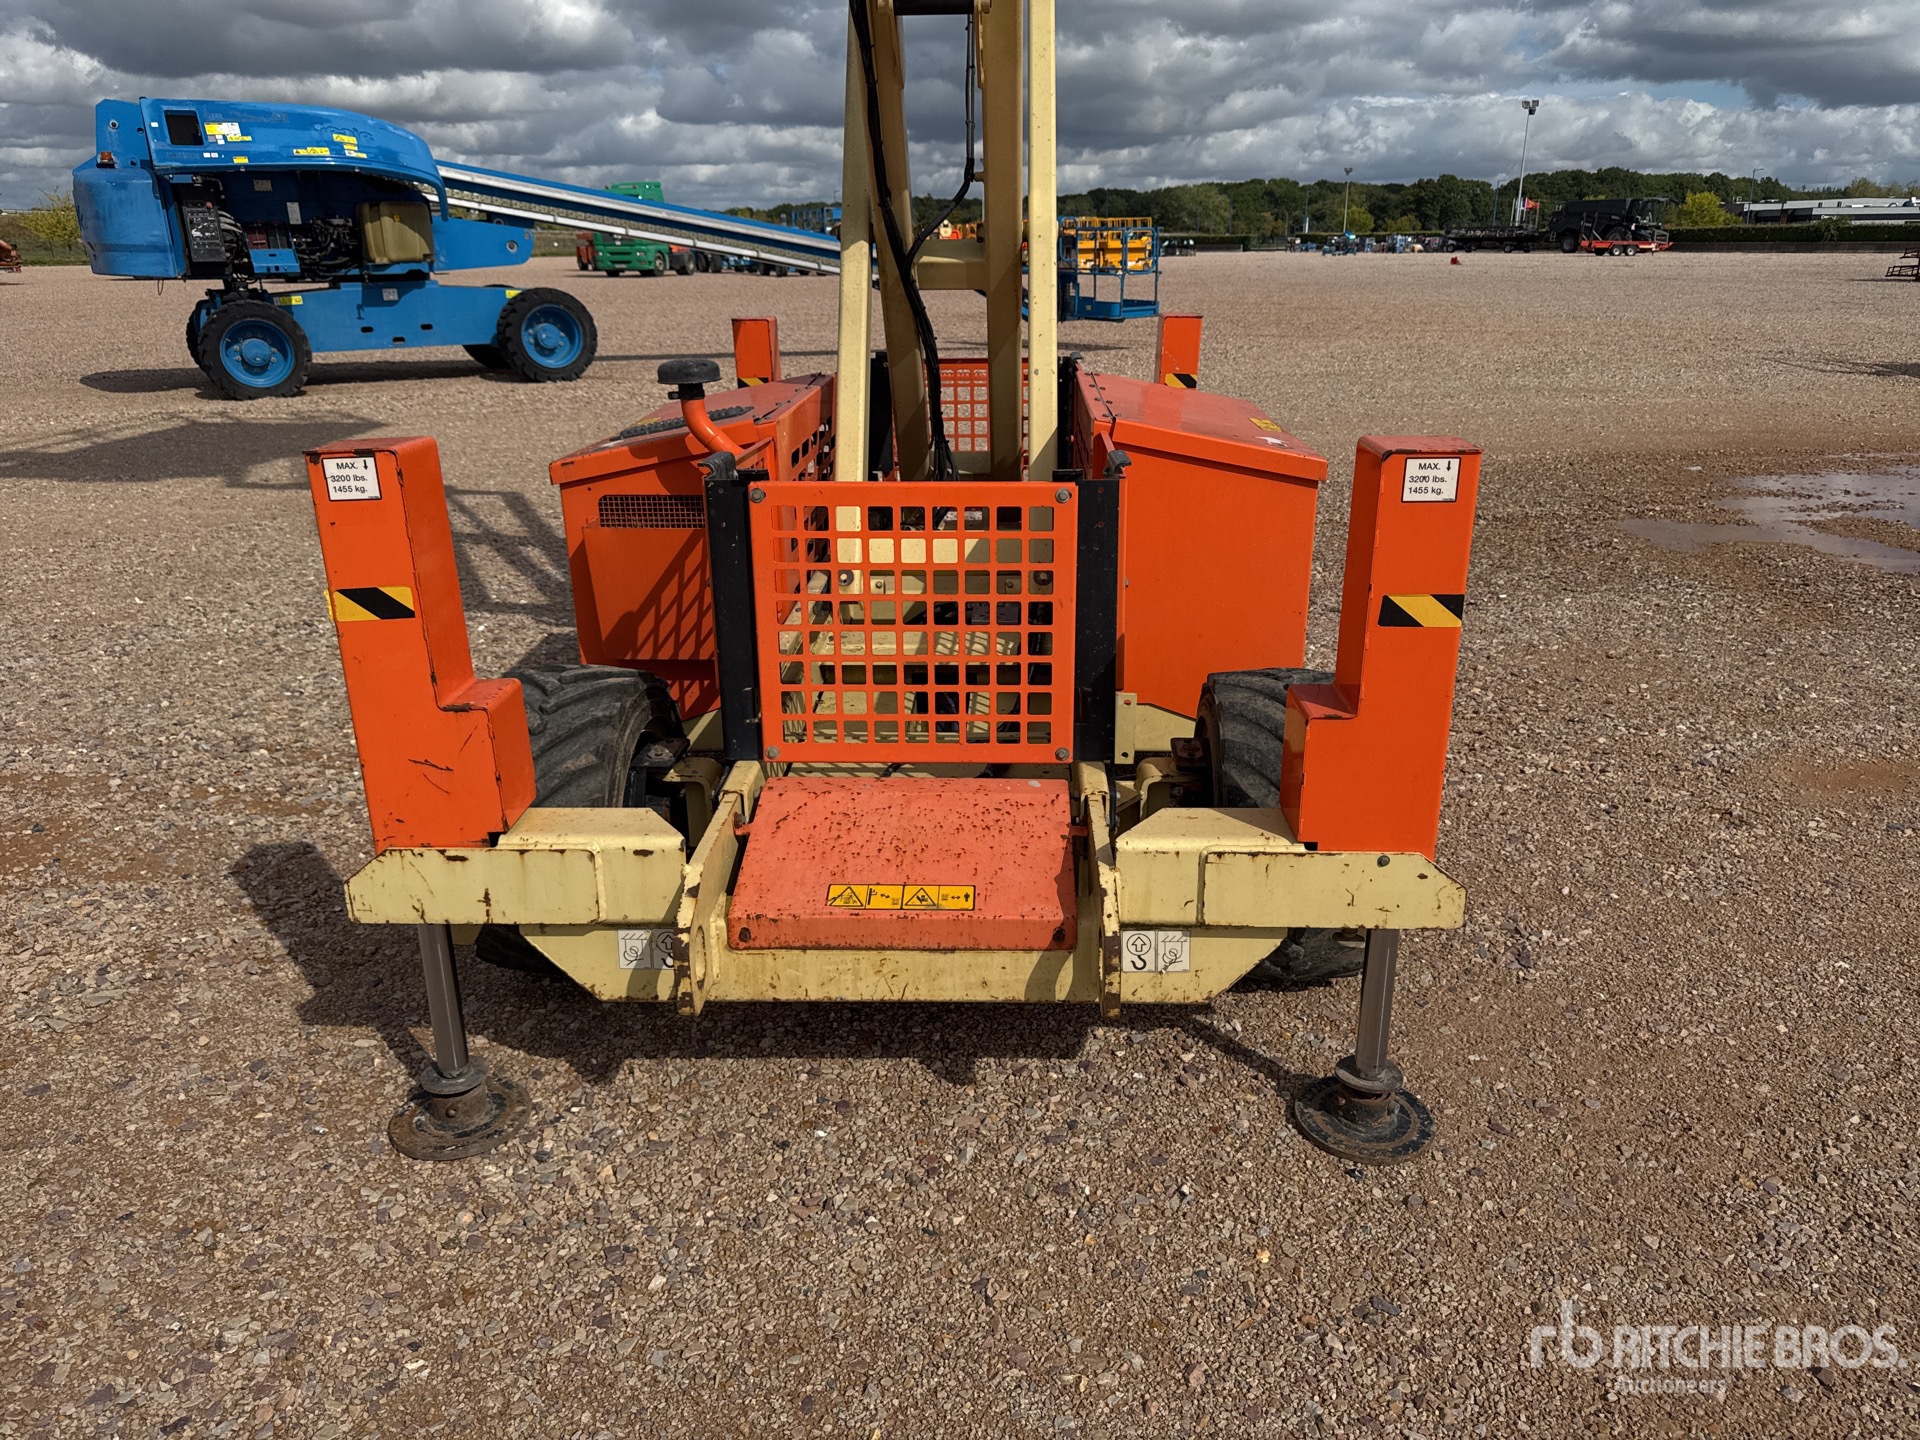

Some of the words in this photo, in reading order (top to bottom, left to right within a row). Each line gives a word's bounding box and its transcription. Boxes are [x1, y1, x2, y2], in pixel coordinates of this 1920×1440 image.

[336, 462, 359, 470] MAX.
[1418, 462, 1441, 470] MAX.
[330, 474, 351, 482] 3200
[352, 474, 368, 482] lbs.
[1408, 475, 1430, 483] 3200
[1432, 475, 1447, 483] lbs.
[333, 485, 353, 493] 1455
[354, 485, 368, 495] kg.
[1408, 487, 1429, 495] 1455
[1431, 486, 1444, 496] kg.
